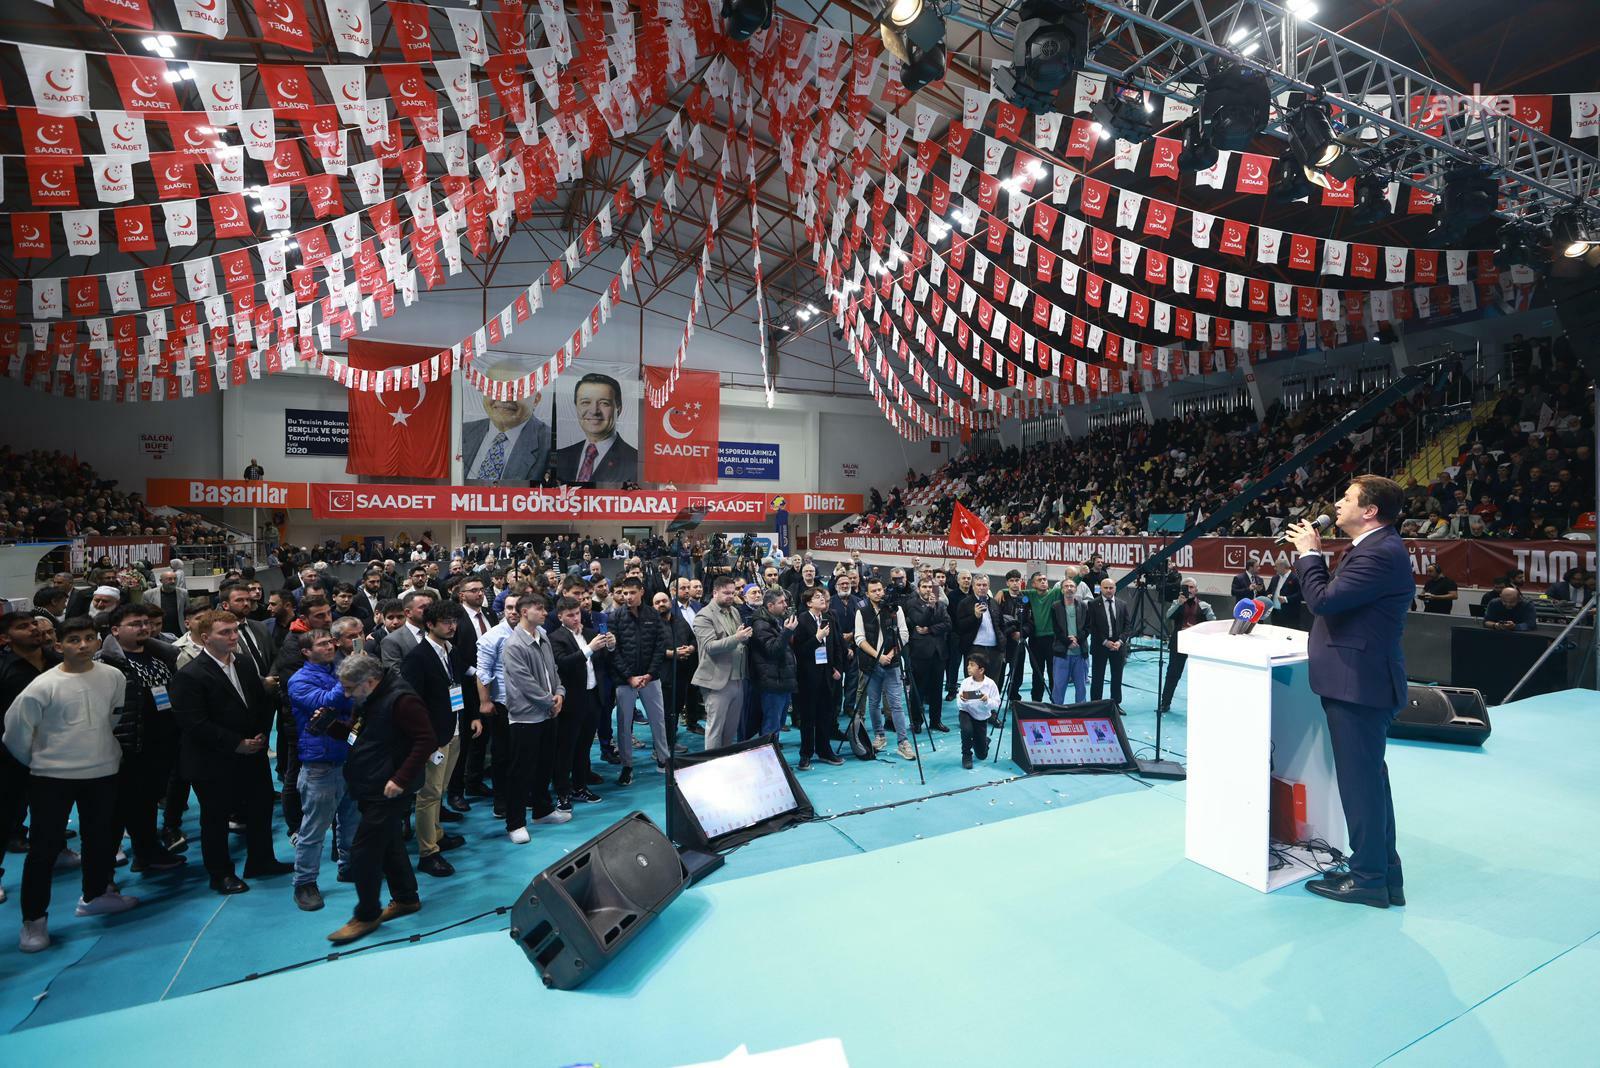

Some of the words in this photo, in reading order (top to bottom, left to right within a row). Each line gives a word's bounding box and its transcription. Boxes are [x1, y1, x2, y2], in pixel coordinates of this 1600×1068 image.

[43, 92, 86, 102] SAADET
[131, 100, 171, 109] SAADET
[277, 101, 309, 110] SAADET
[34, 146, 74, 155] SAADET
[111, 142, 142, 150] SAADET
[654, 443, 710, 457] SAADET
[189, 482, 288, 506] Başarılar
[356, 494, 436, 509] SAADET
[707, 500, 763, 513] SAADET
[804, 495, 845, 511] Dileriz
[988, 544, 998, 557] ve
[999, 539, 1017, 558] YENİ
[1018, 539, 1031, 559] BİR
[1033, 539, 1061, 560] DÜNYA
